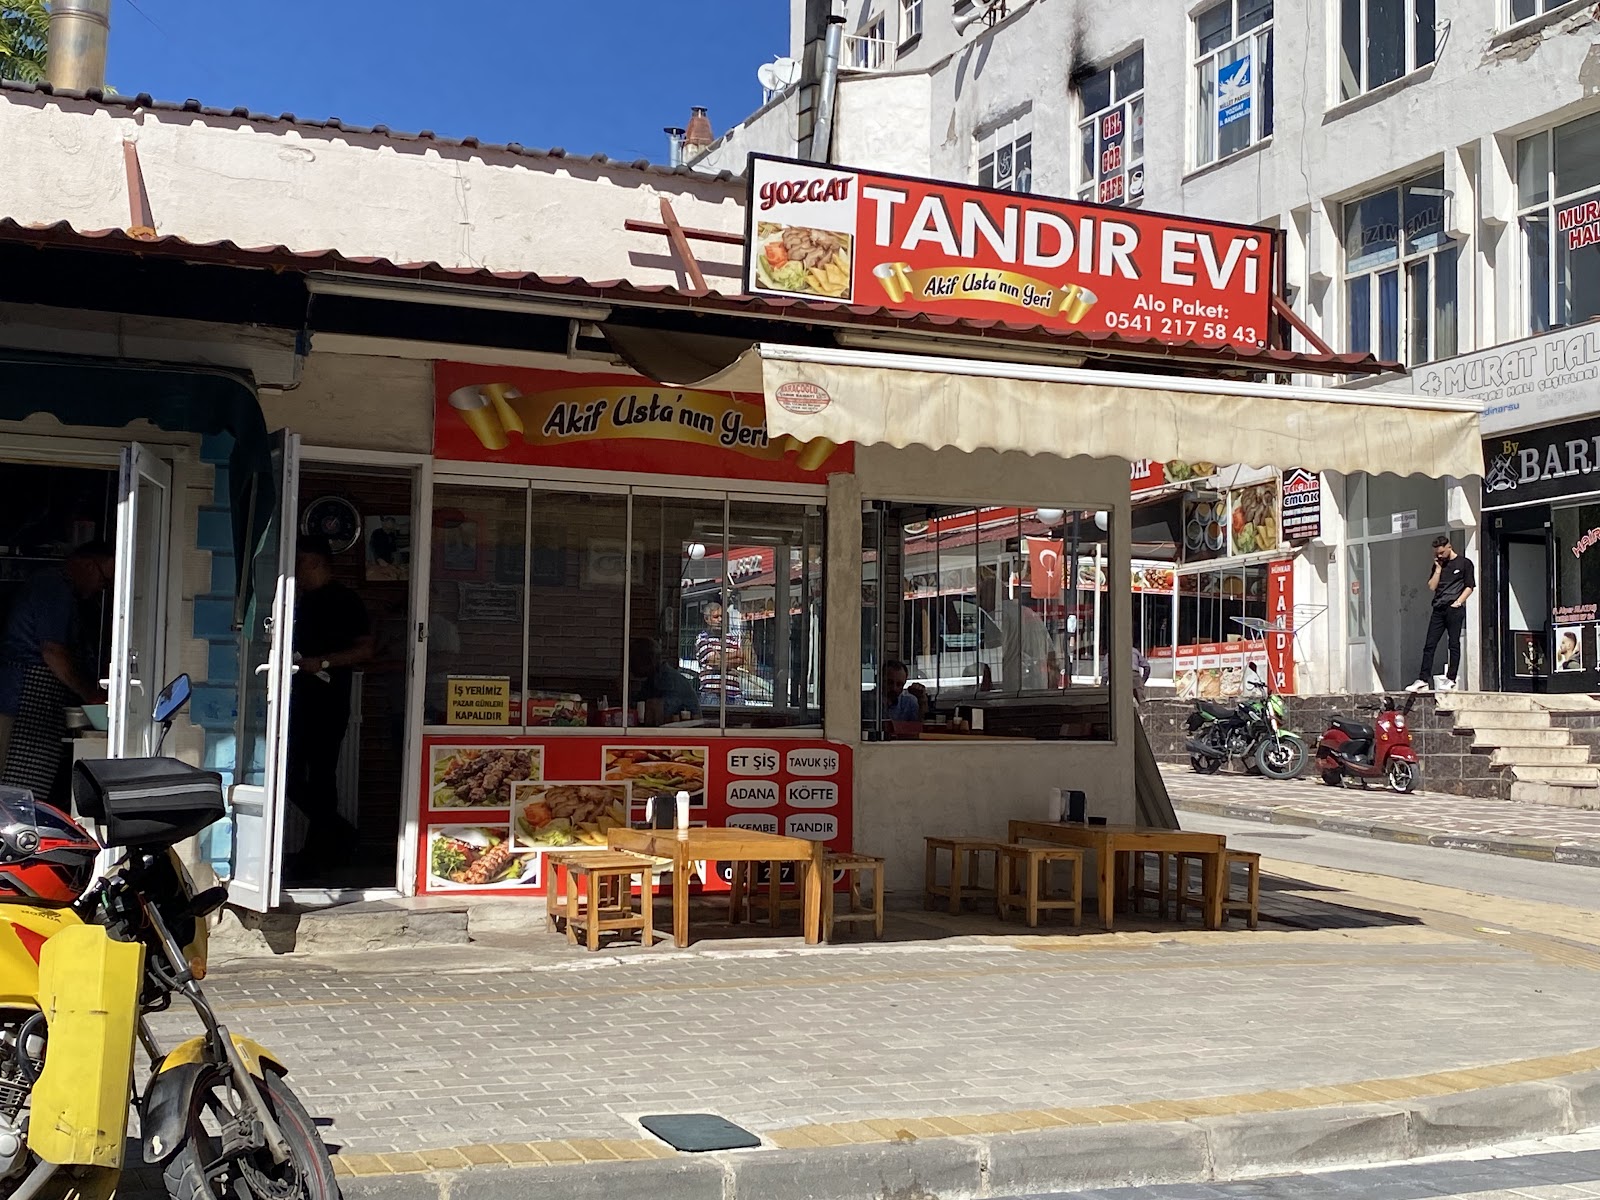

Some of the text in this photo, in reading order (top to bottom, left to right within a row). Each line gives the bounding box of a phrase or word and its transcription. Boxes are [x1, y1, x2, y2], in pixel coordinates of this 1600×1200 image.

[1103, 111, 1122, 140] GEL
[1102, 142, 1121, 174] GÖR
[760, 176, 854, 211] YOZGAT
[1099, 174, 1124, 204] CAFE
[1558, 200, 1600, 232] MUR
[862, 185, 1141, 282] TANDIR
[924, 272, 1052, 308] Akif Usta'nın Yeri
[1133, 293, 1230, 320] Alo Paket:
[1105, 311, 1257, 344] 0541 217 58 43
[1444, 346, 1538, 396] MURAT
[542, 393, 769, 447] Akif Usta'nın Yeri
[1484, 402, 1520, 416] dinarsu
[1502, 440, 1519, 456] By
[1284, 492, 1319, 507] EMLAK
[453, 699, 504, 708] PAZAR GÜNLERİ
[454, 684, 503, 697] İŞ YERİMİZ
[455, 711, 502, 721] KAPALIDIR
[731, 753, 837, 770] ET ŞİŞ TAVUK ŞİŞ
[730, 785, 834, 800] ADANA KÖFTE
[789, 823, 834, 833] TANDIR
[764, 867, 790, 879] 27
